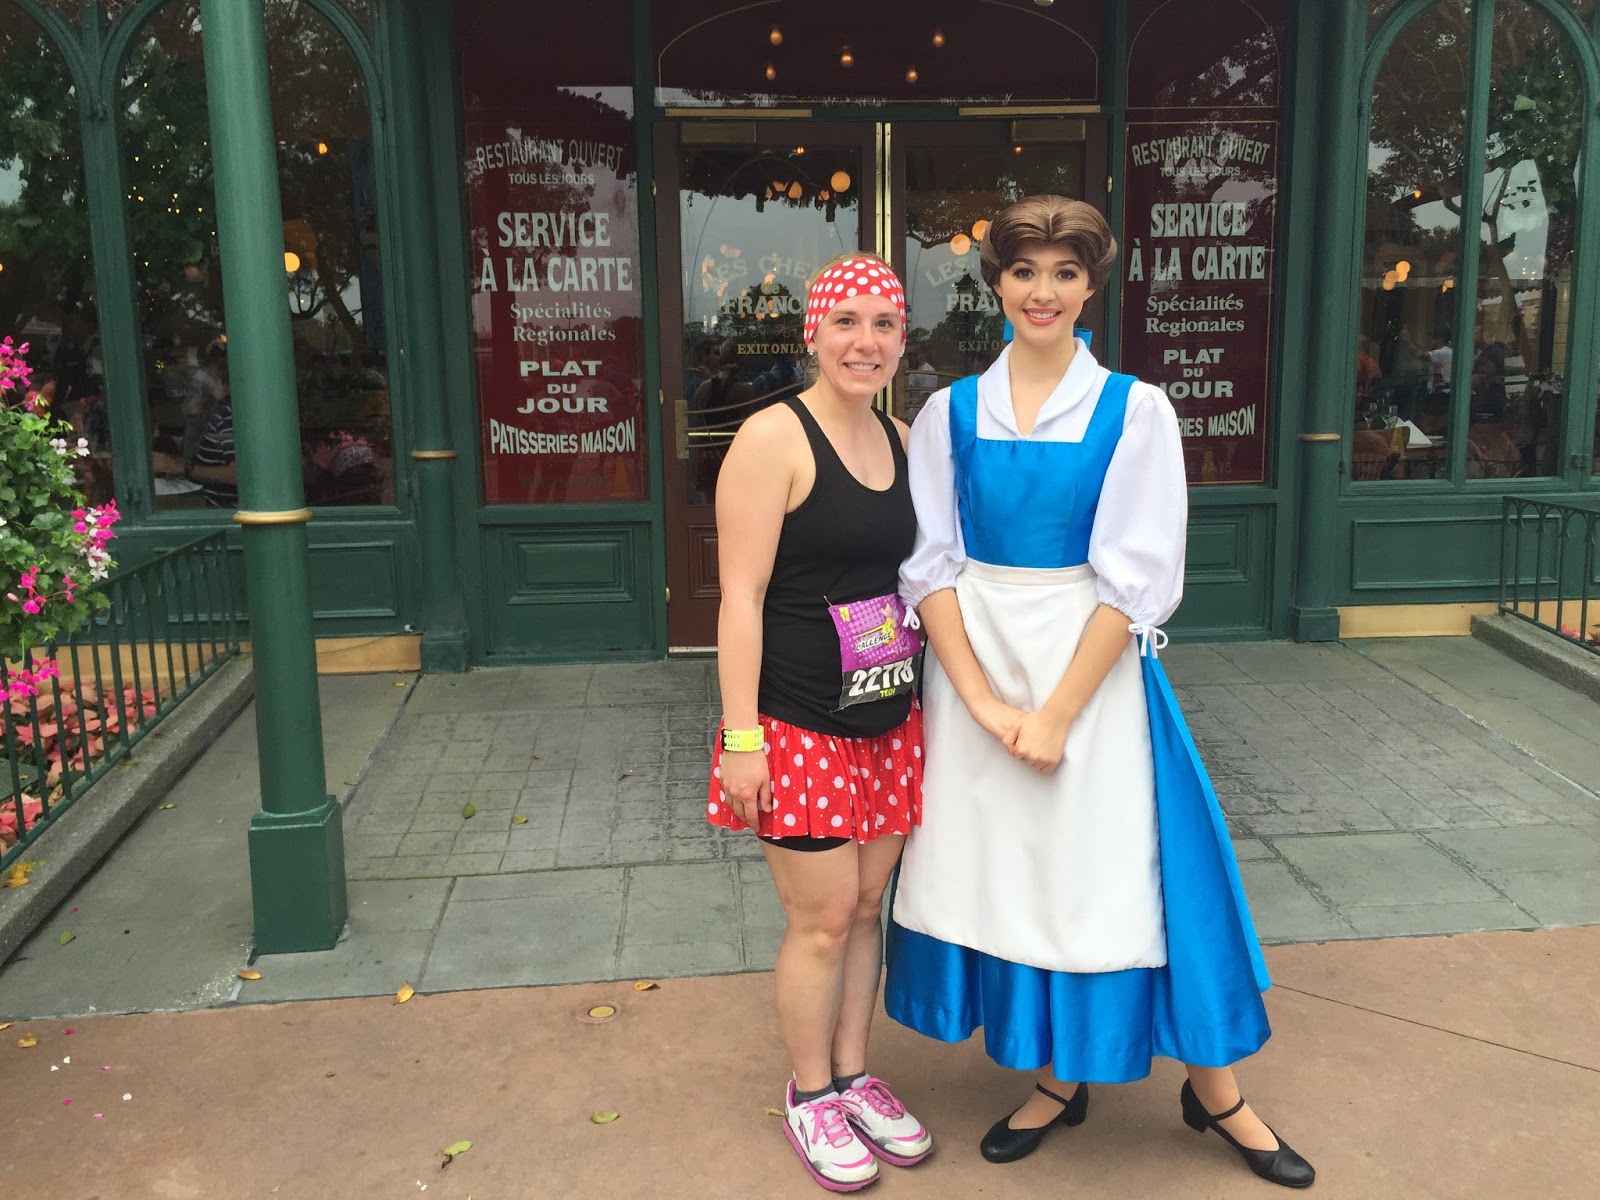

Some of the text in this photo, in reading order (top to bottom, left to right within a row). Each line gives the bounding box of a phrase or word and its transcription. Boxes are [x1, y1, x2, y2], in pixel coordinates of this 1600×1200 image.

[476, 139, 623, 171] RESTAURANT OUVERT
[1132, 135, 1270, 167] RESTAURANT OUVERT
[509, 173, 595, 185] TOUS LES JOURS
[1160, 166, 1241, 177] TOUS LES JOURS
[497, 212, 611, 248] SERVICE
[1150, 202, 1247, 238] SERVICE
[480, 247, 633, 292] À LA CARTE
[1128, 238, 1266, 282] À LA CARTE
[927, 257, 969, 288] LES
[761, 283, 780, 295] de
[510, 302, 612, 323] Spécialités
[1146, 293, 1244, 316] Spécialités
[513, 325, 616, 346] Regionales
[1145, 317, 1245, 337] Regionales
[737, 342, 806, 355] EXIT ONLY
[958, 340, 989, 351] EXIT
[1163, 348, 1225, 365] PLAT
[520, 360, 603, 377] PLAT
[1183, 368, 1204, 378] DU
[547, 383, 577, 394] DU
[516, 397, 610, 414] JOUR
[1207, 403, 1256, 437] MAISON
[490, 416, 636, 455] PATISSERIES MAISON
[848, 656, 914, 697] 22778
